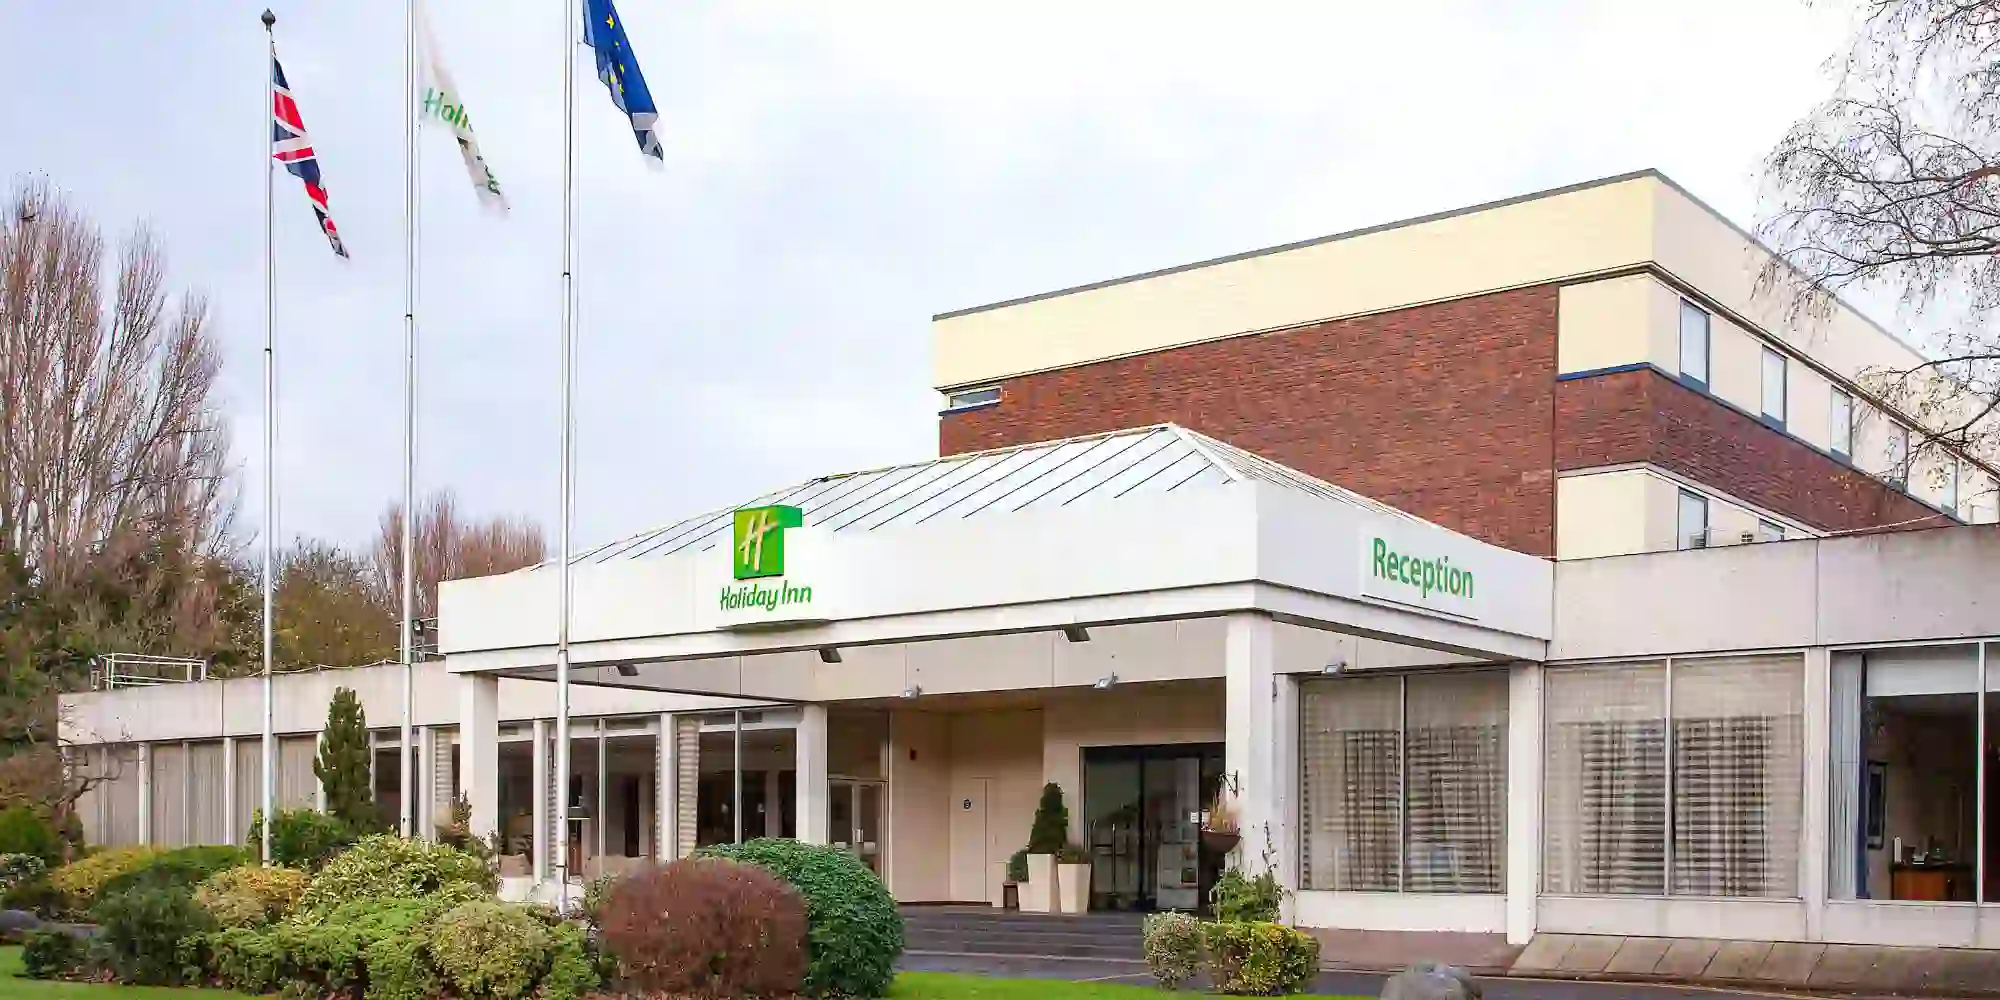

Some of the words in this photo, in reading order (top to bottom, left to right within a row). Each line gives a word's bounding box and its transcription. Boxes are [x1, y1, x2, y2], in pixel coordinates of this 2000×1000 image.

[1373, 537, 1474, 599] Reception
[720, 583, 778, 612] Holiday
[781, 580, 812, 604] Inn
